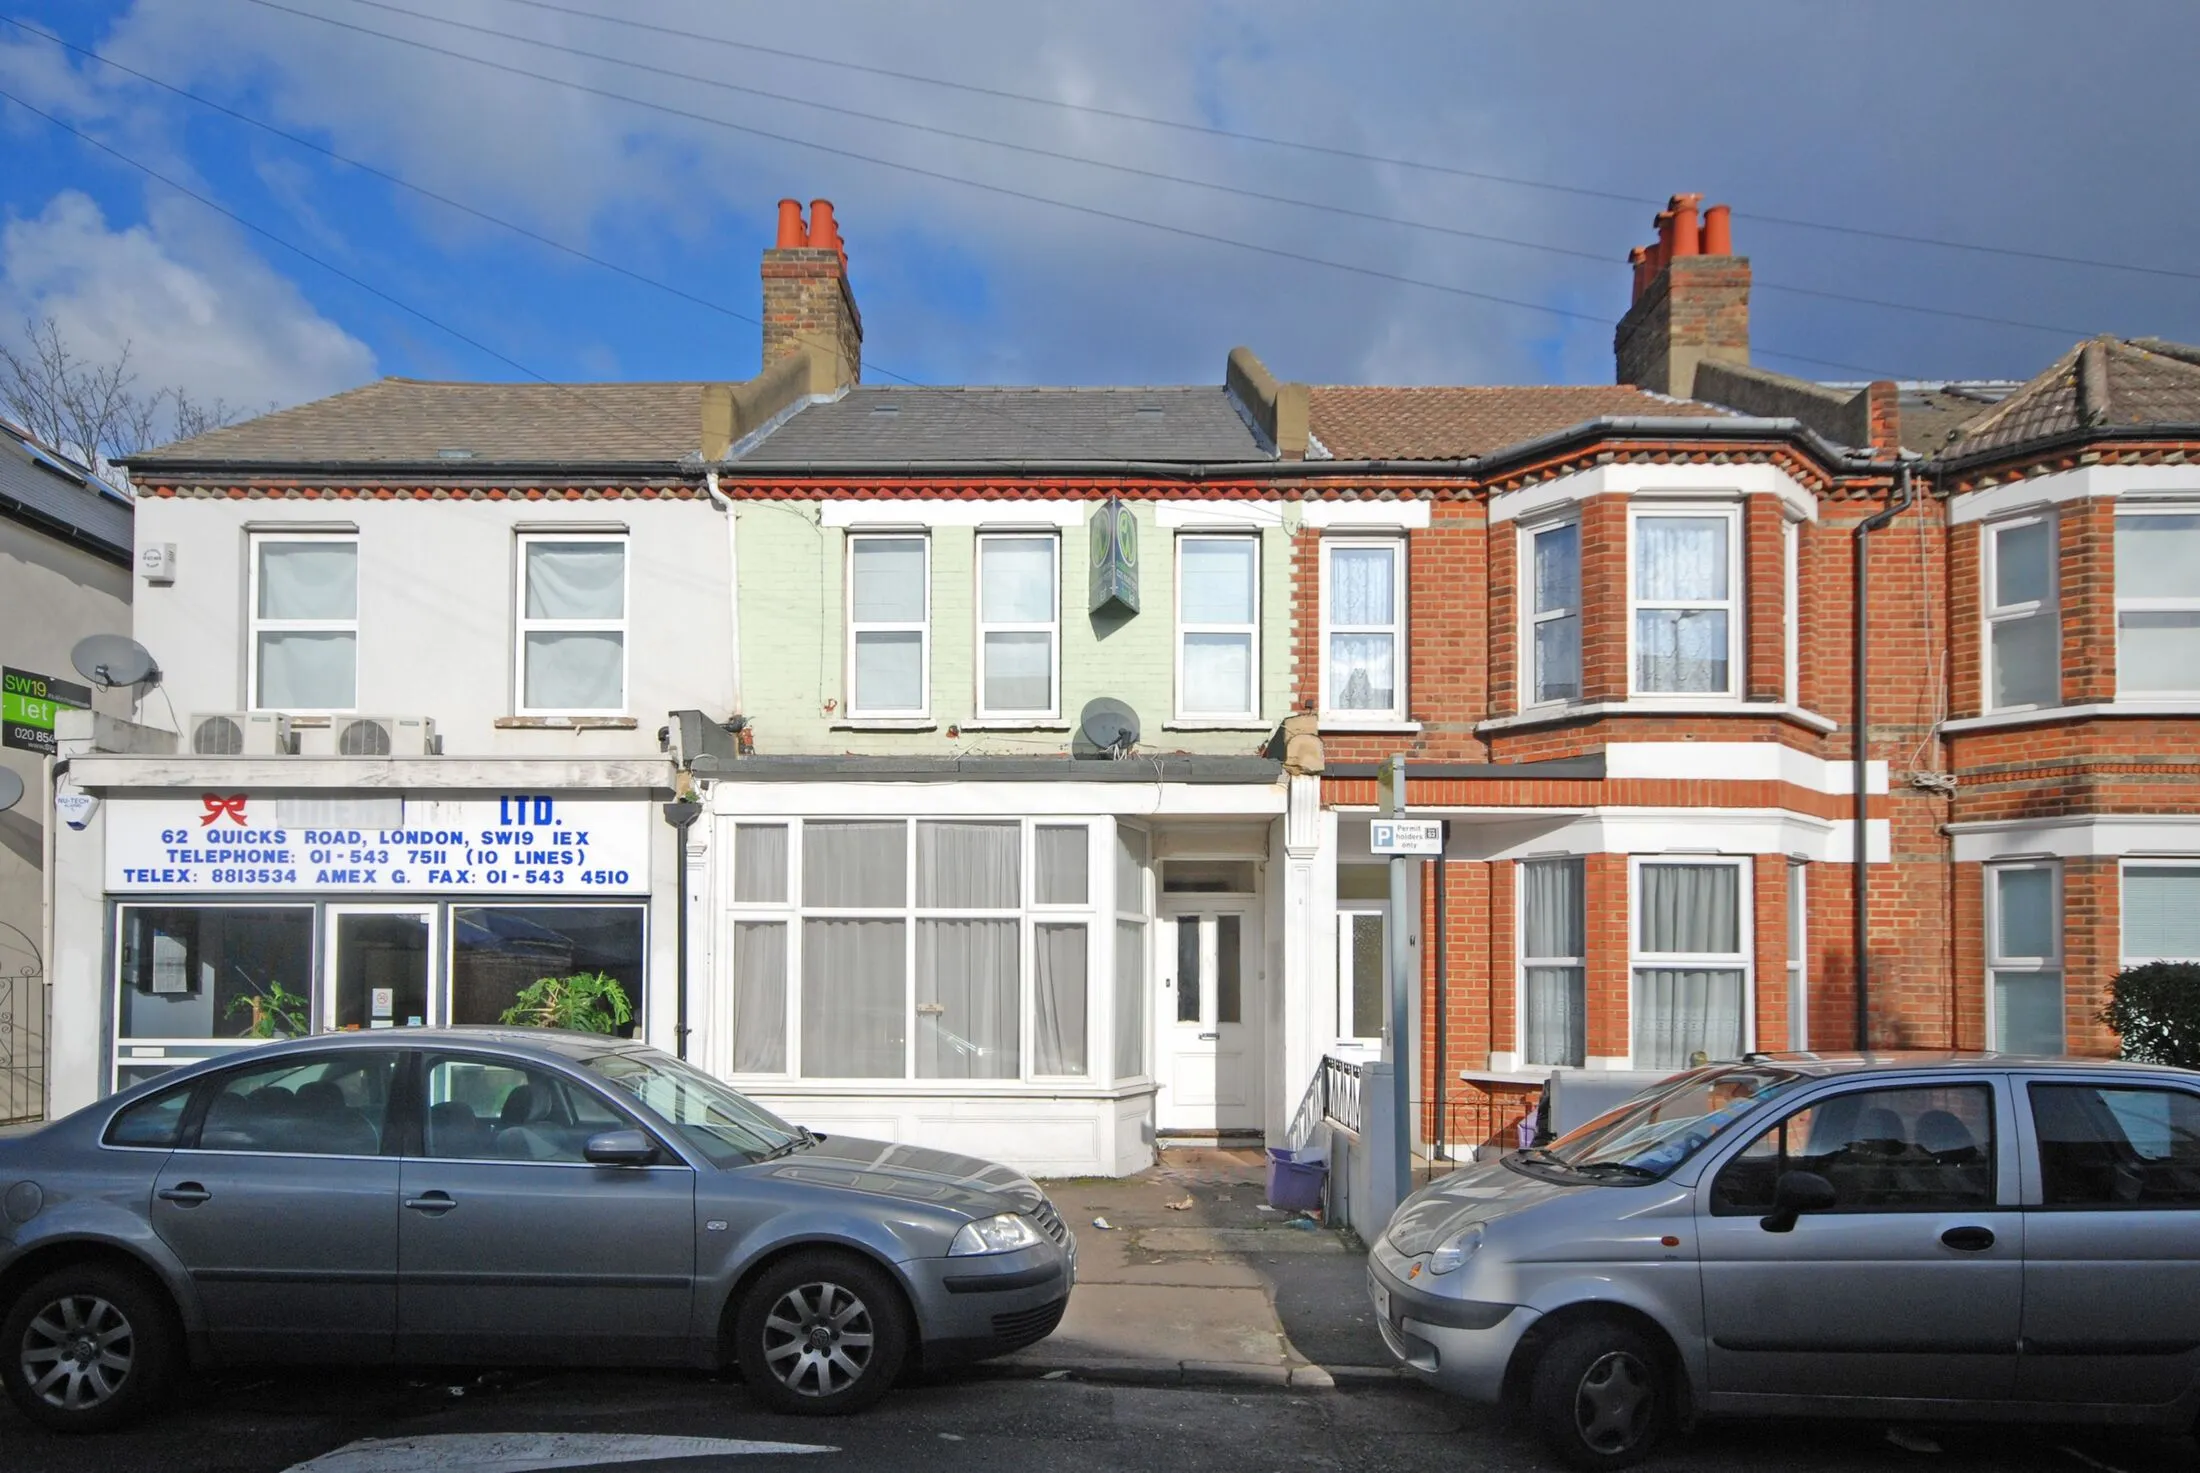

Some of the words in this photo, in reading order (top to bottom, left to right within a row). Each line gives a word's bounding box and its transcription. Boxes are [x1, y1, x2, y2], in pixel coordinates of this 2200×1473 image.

[5, 674, 47, 698] SW19
[20, 697, 49, 721] let
[14, 727, 35, 741] 020
[500, 795, 563, 827] LTD.
[161, 829, 189, 845] 62
[207, 829, 287, 845] QUICKS
[304, 830, 367, 848] ROAD,
[379, 830, 470, 848] LONDON,
[481, 831, 535, 846] SW19
[1377, 828, 1391, 846] P
[166, 849, 296, 865] TELEPHONE:
[407, 850, 447, 865] 7511
[514, 849, 586, 866] LINES)
[123, 868, 198, 884] TELEX:
[211, 868, 298, 885] 8813534
[315, 869, 377, 884] AMEX
[391, 869, 412, 885] G.
[427, 869, 476, 885] FAX:
[580, 870, 630, 885] 4510
